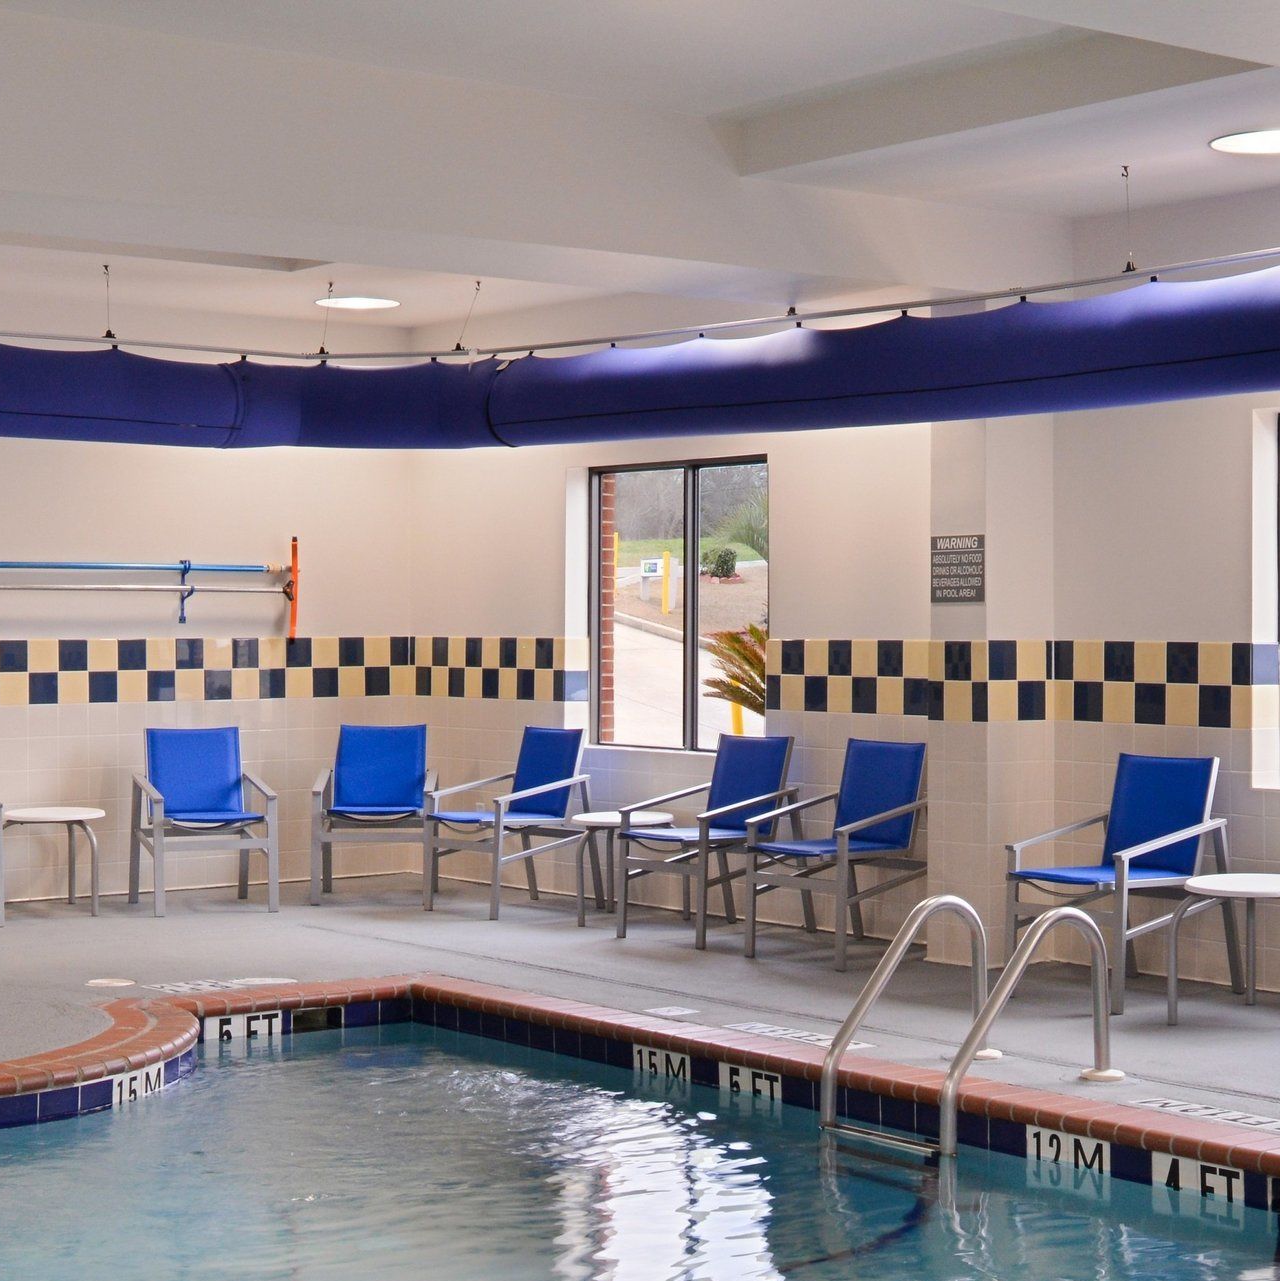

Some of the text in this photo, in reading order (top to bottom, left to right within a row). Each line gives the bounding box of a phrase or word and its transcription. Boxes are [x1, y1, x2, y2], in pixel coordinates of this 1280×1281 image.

[937, 537, 978, 549] WARNING
[247, 1013, 278, 1038] FT
[1074, 1138, 1103, 1174] M
[1200, 1165, 1239, 1202] FT
